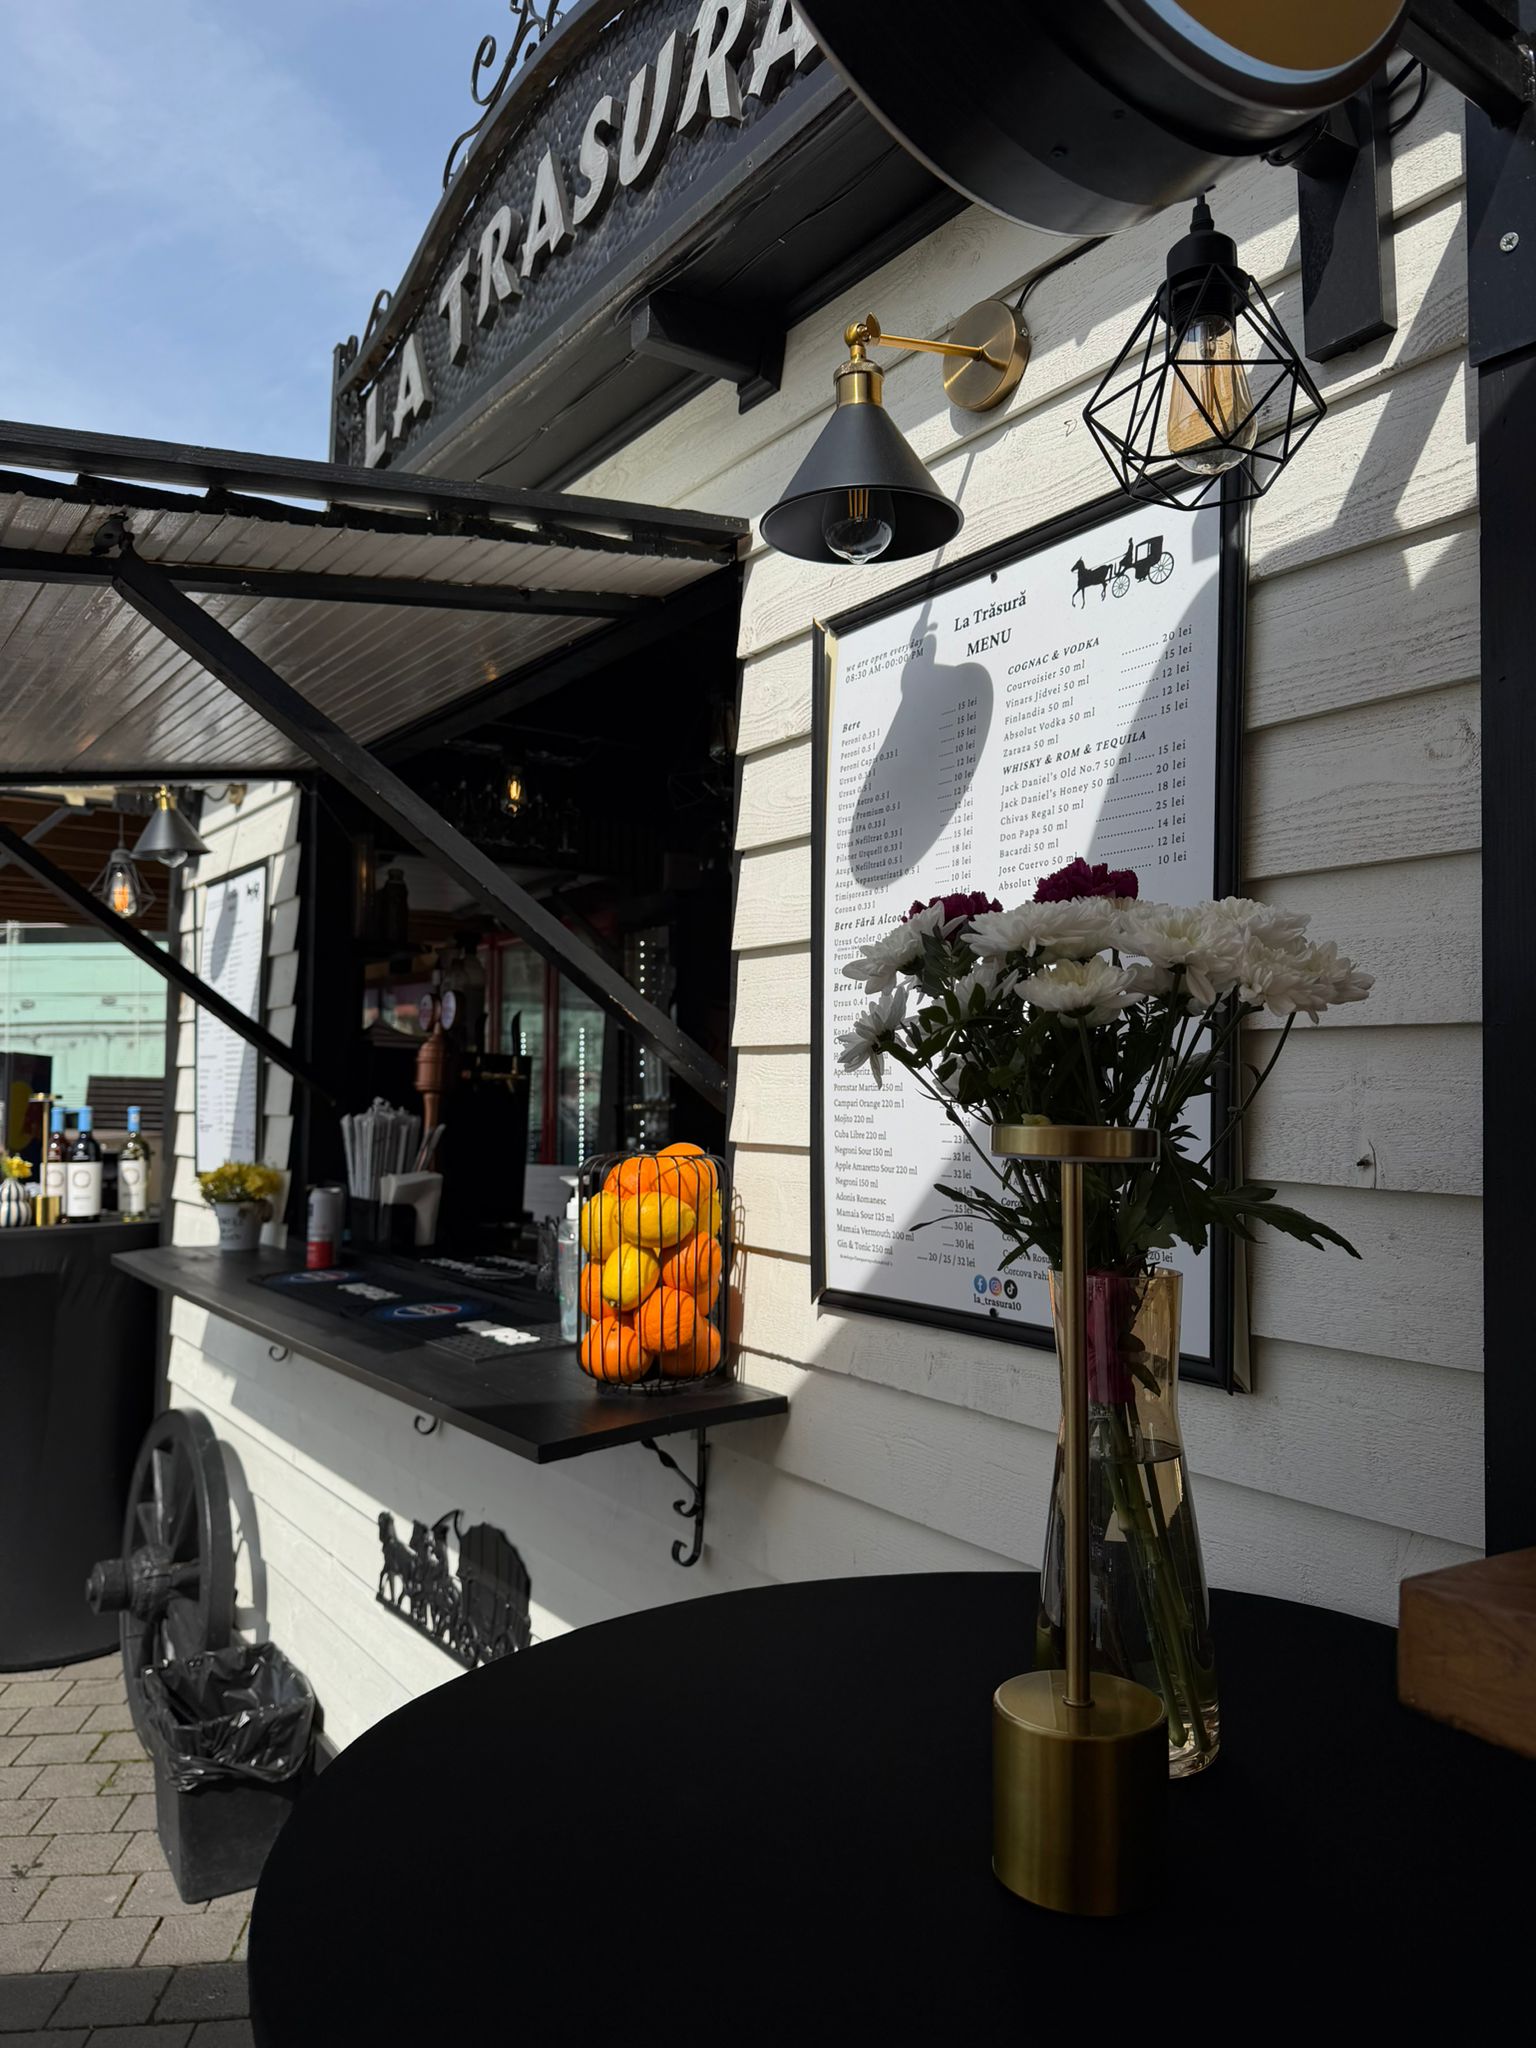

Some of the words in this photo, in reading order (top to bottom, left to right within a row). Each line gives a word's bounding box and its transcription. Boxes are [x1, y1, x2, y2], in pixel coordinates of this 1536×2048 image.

[364, 333, 432, 469] LA
[954, 617, 970, 632] La
[973, 591, 1026, 624] Trăsură
[967, 628, 1011, 656] MENU
[845, 669, 867, 684] 08:30
[910, 647, 924, 660] PM
[846, 664, 855, 672] we
[857, 659, 869, 669] are
[870, 652, 888, 665] open
[1006, 671, 1056, 693] Courvoisier
[1059, 665, 1071, 676] 50
[1073, 659, 1085, 672] ml
[1162, 631, 1175, 643] 20
[1178, 624, 1192, 638] lei
[1008, 654, 1049, 675] COGNAC
[1051, 650, 1059, 661] &
[1063, 637, 1099, 656] VODKA
[1005, 695, 1033, 708] Vinars
[1034, 683, 1060, 703] Jidvei
[1063, 680, 1075, 691] 50
[1077, 674, 1089, 687] ml
[1165, 648, 1175, 660] 15
[1178, 642, 1192, 656] lei
[1005, 706, 1045, 725] Finlandia
[1048, 701, 1059, 712] 50
[1062, 696, 1073, 708] ml
[1162, 667, 1172, 678] 12
[1176, 661, 1189, 674] lei
[1003, 726, 1037, 741] Absolut
[1039, 717, 1066, 730] Vodka
[1069, 712, 1080, 723] 50
[1083, 706, 1095, 719] ml
[1162, 685, 1173, 696] 12
[1176, 679, 1189, 692] lei
[842, 721, 861, 733] Bere
[1003, 744, 1031, 758] Zaraza
[1033, 739, 1045, 750] 50
[1047, 734, 1059, 746] ml
[1161, 703, 1171, 715] 15
[1174, 698, 1188, 711] lei
[1003, 757, 1042, 774] WHISKY
[1044, 754, 1052, 765] &
[1056, 747, 1080, 762] ROM
[1083, 744, 1091, 755] &
[1096, 731, 1145, 751] TEQUILA
[1000, 781, 1019, 796] Jack
[1021, 772, 1057, 788] Daniel's
[1060, 766, 1076, 779] Old
[1079, 761, 1101, 774] No.7
[1103, 757, 1115, 769] 50
[1118, 752, 1131, 765] ml
[1158, 744, 1169, 755] 15
[1172, 739, 1186, 752] lei
[1000, 797, 1018, 812] Jack
[1021, 789, 1056, 805] Daniel's
[1059, 783, 1089, 796] Honey
[1091, 778, 1103, 789] 50
[1106, 773, 1119, 785] ml
[1156, 762, 1169, 774] 20
[1172, 757, 1186, 770] lei
[1000, 814, 1028, 825] Chivas
[1031, 805, 1055, 820] Regal
[1058, 803, 1069, 813] 50
[1072, 798, 1084, 810] ml
[1158, 780, 1169, 792] 18
[1172, 776, 1186, 789] lei
[855, 824, 866, 832] IPA
[999, 832, 1017, 842] Don
[1019, 828, 1039, 839] Papa
[1042, 823, 1054, 834] 50
[1056, 819, 1068, 831] ml
[1155, 799, 1167, 810] 25
[1171, 795, 1185, 807] lei
[999, 843, 1031, 858] Bacardi
[1033, 841, 1045, 852] 50
[1047, 838, 1059, 849] ml
[1158, 818, 1168, 828] 14
[1172, 813, 1186, 826] lei
[998, 865, 1016, 877] Jose
[1018, 859, 1049, 871] Cuervo
[1051, 855, 1063, 866] 50
[1066, 852, 1079, 863] ml
[1158, 836, 1168, 846] 12
[1171, 832, 1185, 844] lei
[998, 878, 1031, 891] Absolut
[1158, 854, 1170, 865] 10
[1173, 850, 1187, 862] lei
[834, 905, 856, 914] Corona
[857, 901, 871, 911] 0.33
[834, 922, 853, 931] Bere
[855, 916, 875, 928] Fără
[834, 938, 852, 947] Ursus
[853, 934, 876, 944] Cooler
[833, 982, 852, 992] Bere
[854, 980, 863, 990] la
[833, 1000, 851, 1008] Ursus
[833, 1083, 858, 1092] Pornstar
[833, 1098, 858, 1109] Campari
[858, 1099, 881, 1110] Orange
[834, 1113, 853, 1124] Mojito
[834, 1129, 849, 1139] Cuba
[849, 1129, 865, 1139] Libre
[834, 1145, 857, 1156] Negroni
[858, 1146, 872, 1156] Sour
[953, 1152, 961, 1161] 32
[961, 1151, 971, 1162] lei
[834, 1160, 851, 1172] Apple
[852, 1162, 880, 1172] Amaretto
[880, 1164, 895, 1174] Sour
[953, 1169, 962, 1179] 32
[962, 1169, 972, 1180] lei
[835, 1177, 858, 1188] Negroni
[835, 1192, 856, 1202] Adonis
[856, 1194, 886, 1205] Romanesc
[836, 1208, 860, 1218] Mamaia
[860, 1210, 874, 1220] Sour
[954, 1221, 963, 1231] 30
[963, 1221, 973, 1232] lei
[836, 1223, 860, 1234] Mamaia
[860, 1226, 891, 1238] Vermouth
[955, 1238, 965, 1249] 30
[965, 1239, 974, 1250] lei
[836, 1239, 848, 1248] Gin
[848, 1240, 854, 1249] &
[854, 1241, 871, 1252] Tonic
[928, 1252, 938, 1262] 20
[943, 1254, 952, 1264] 25
[957, 1256, 966, 1266] 32
[966, 1256, 975, 1268] lei
[1003, 1266, 1032, 1278] Corcova
[973, 1293, 1022, 1311] la_trasura10
